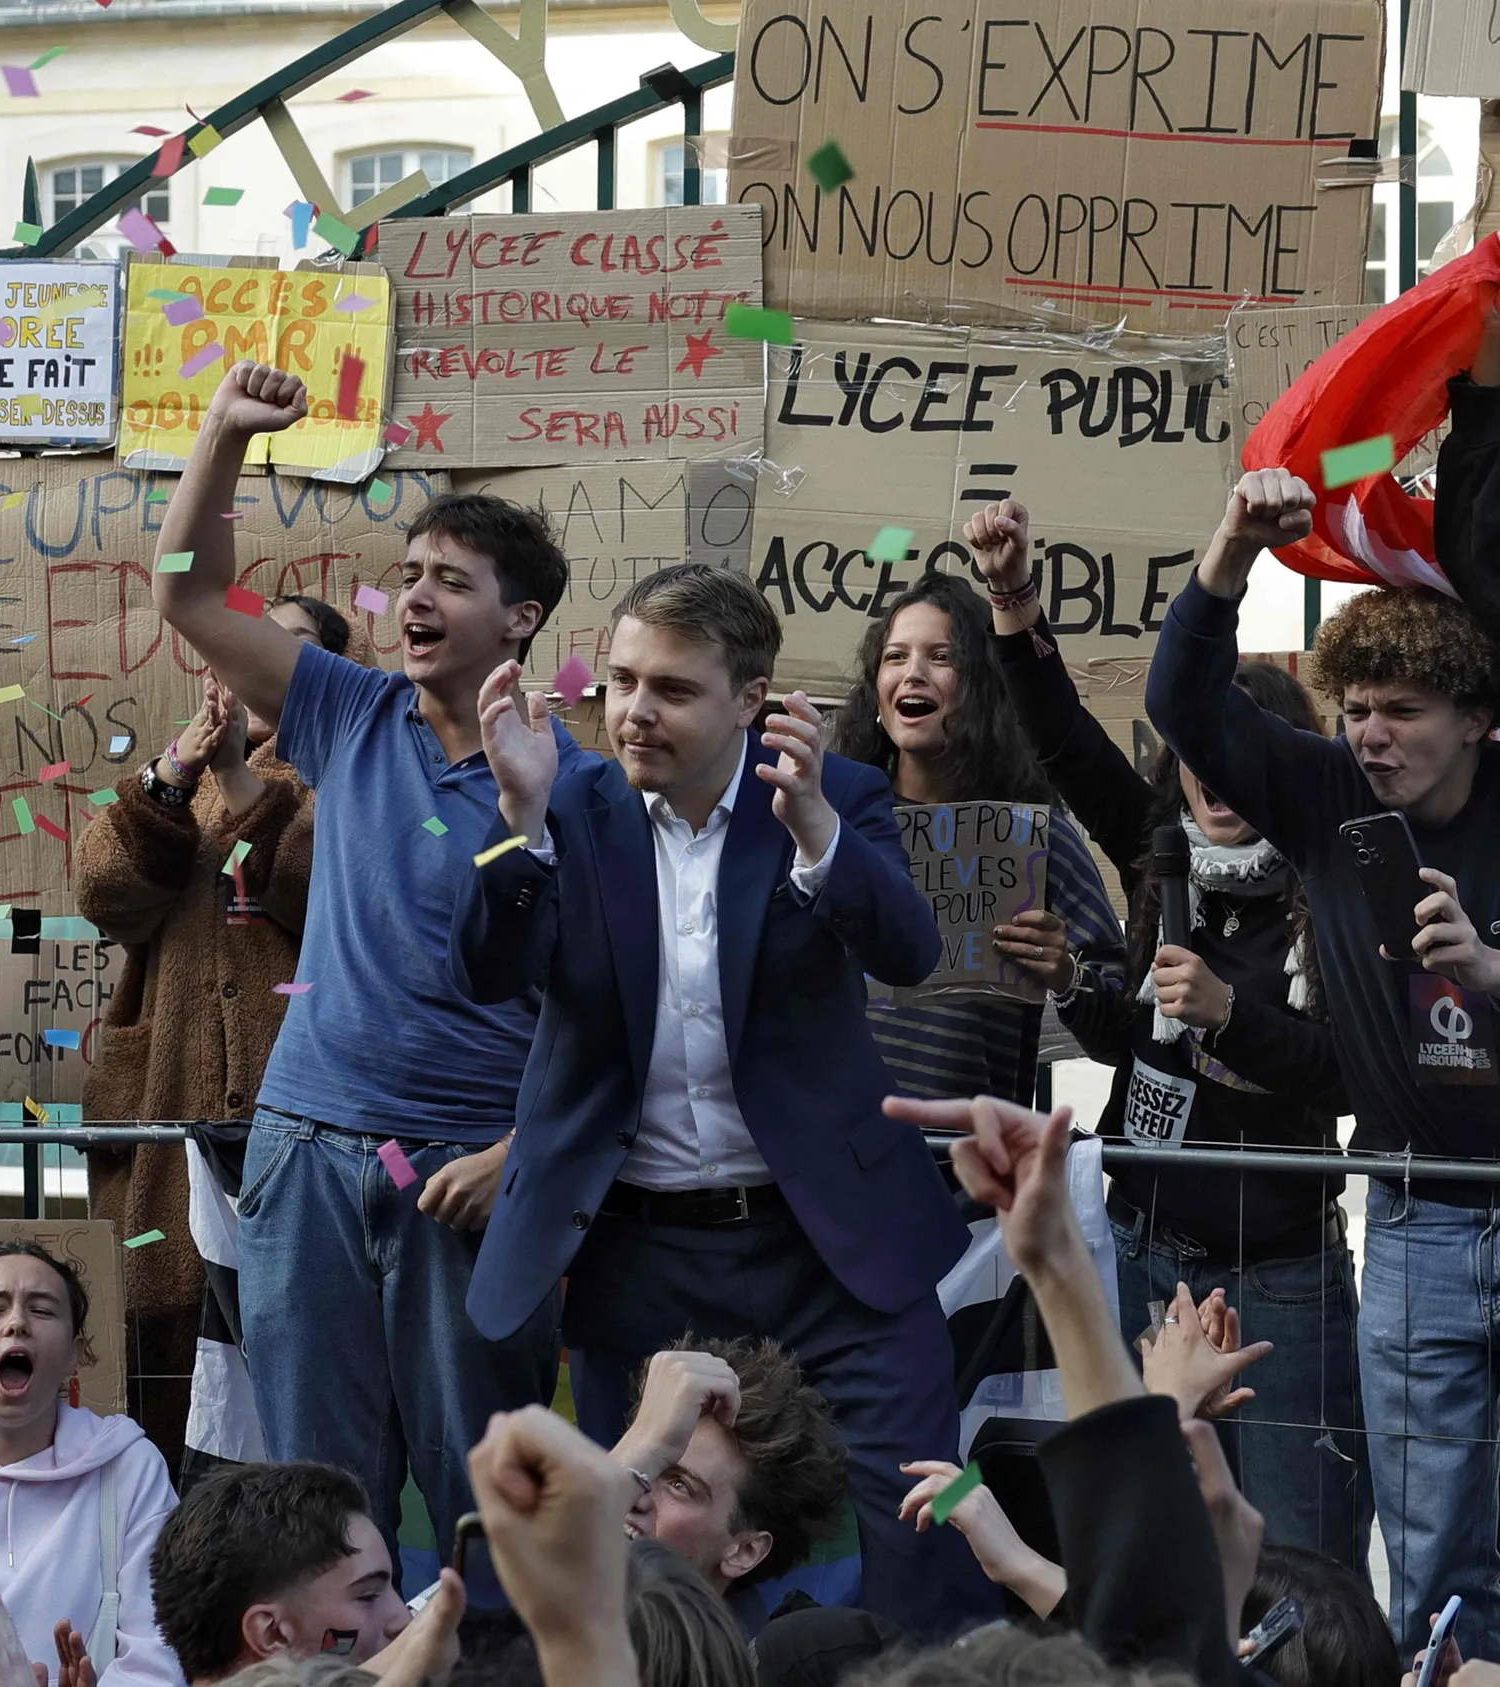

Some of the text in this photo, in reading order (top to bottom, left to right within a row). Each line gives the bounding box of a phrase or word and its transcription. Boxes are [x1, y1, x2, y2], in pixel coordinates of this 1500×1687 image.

[749, 13, 868, 105] ON
[897, 15, 1365, 140] S'EXPRIME
[403, 219, 730, 279] LYCEE CLASSÉ
[738, 182, 1326, 296] ON NOUS OPPRIME.
[177, 270, 329, 318] ACCÈS
[412, 282, 753, 329] HISTORIQUE NOT
[181, 318, 318, 374] PMR
[1235, 320, 1297, 349] C'EST
[27, 353, 97, 389] FAiT
[590, 342, 650, 375] LE
[41, 398, 106, 427] DESSUS
[778, 346, 1231, 448] LYCEE PUBLIC
[506, 401, 741, 449] SERA AUSSi
[15, 697, 137, 774] NOS
[897, 805, 1048, 852] PROF POUR
[909, 854, 1018, 894] ÉLÈVES
[932, 891, 997, 925] POUR
[55, 942, 110, 972] LES
[1128, 1099, 1175, 1139] LE-FEU
[1130, 1074, 1187, 1119] CESSEZ
